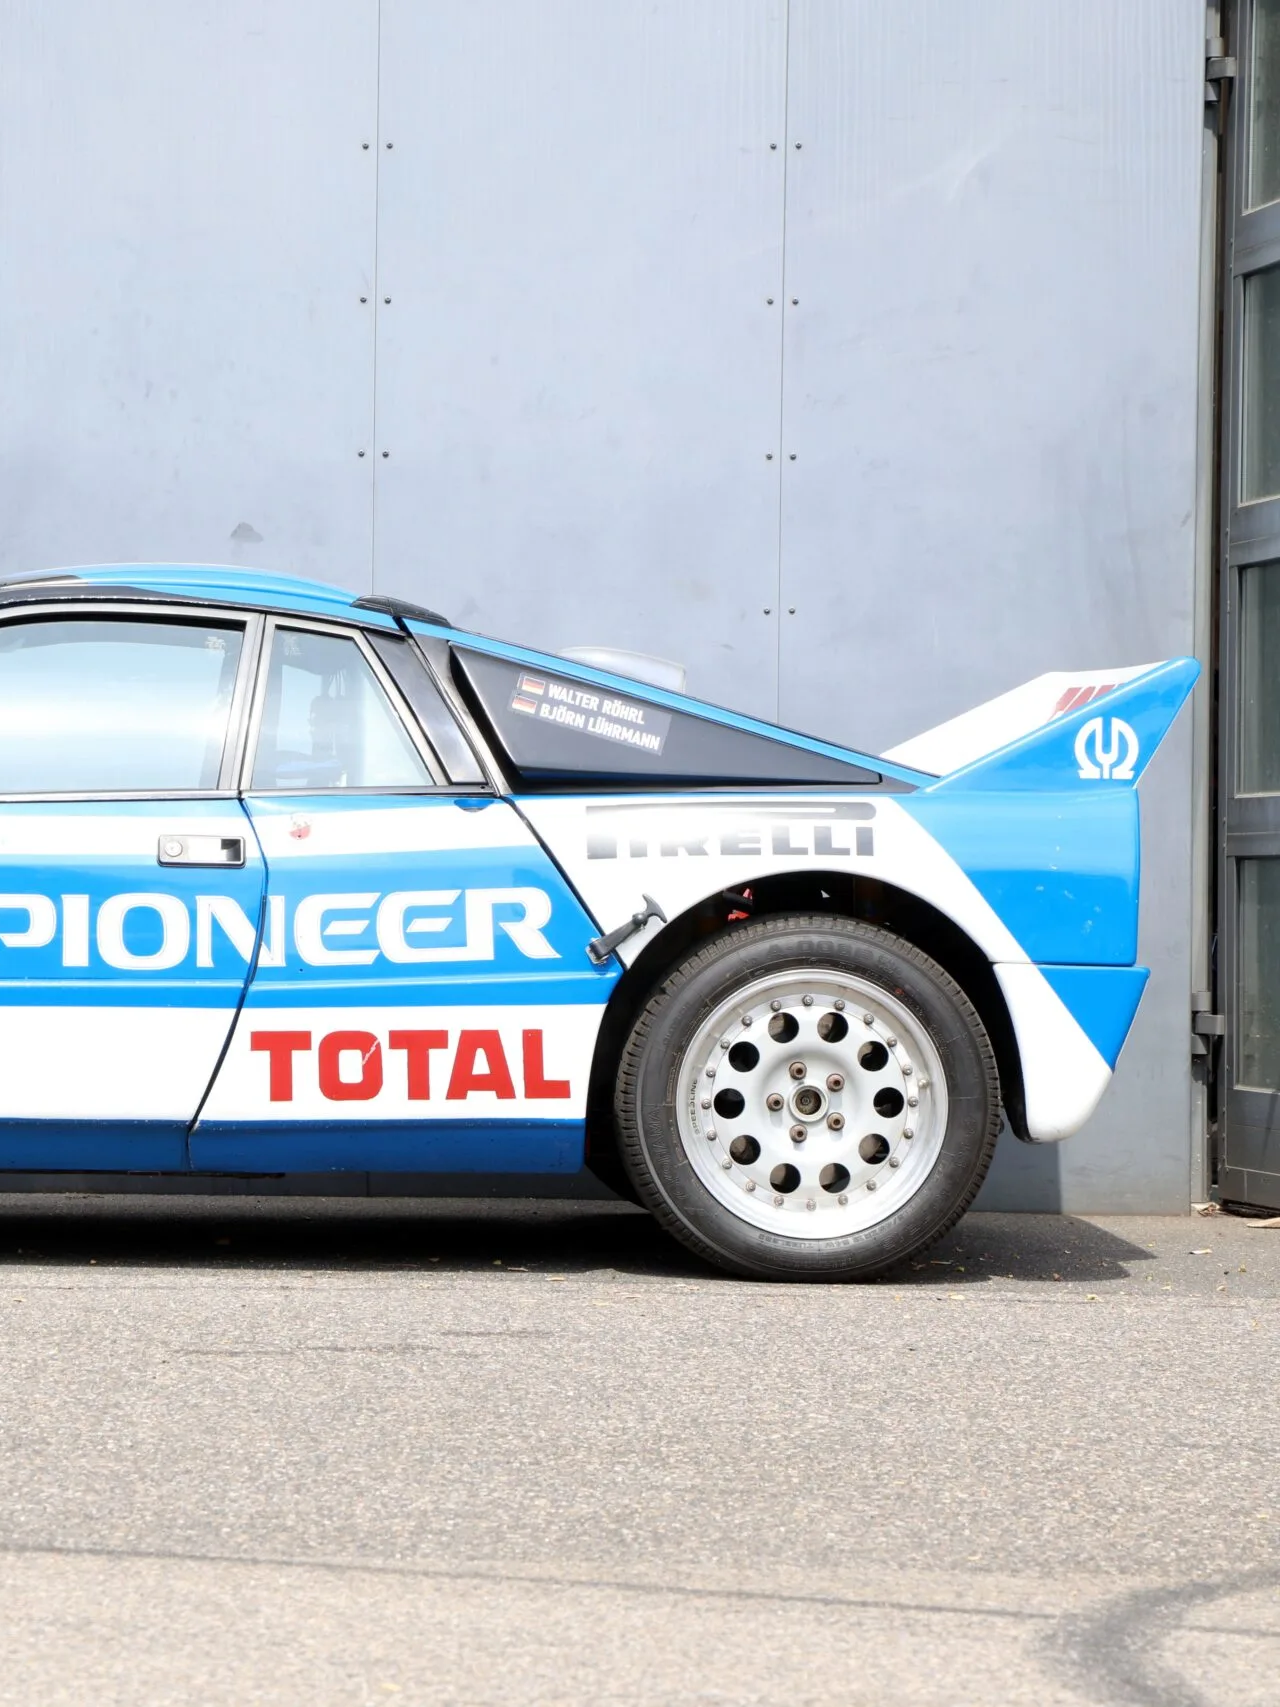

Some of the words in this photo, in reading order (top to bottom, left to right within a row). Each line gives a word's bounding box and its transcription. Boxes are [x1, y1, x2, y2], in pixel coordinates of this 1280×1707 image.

[540, 703, 586, 729] BJÖRN
[587, 715, 661, 750] LÜHRMANN
[548, 684, 599, 711] WALTER
[602, 700, 645, 725] RÖHRL
[250, 1028, 571, 1102] TOTAL
